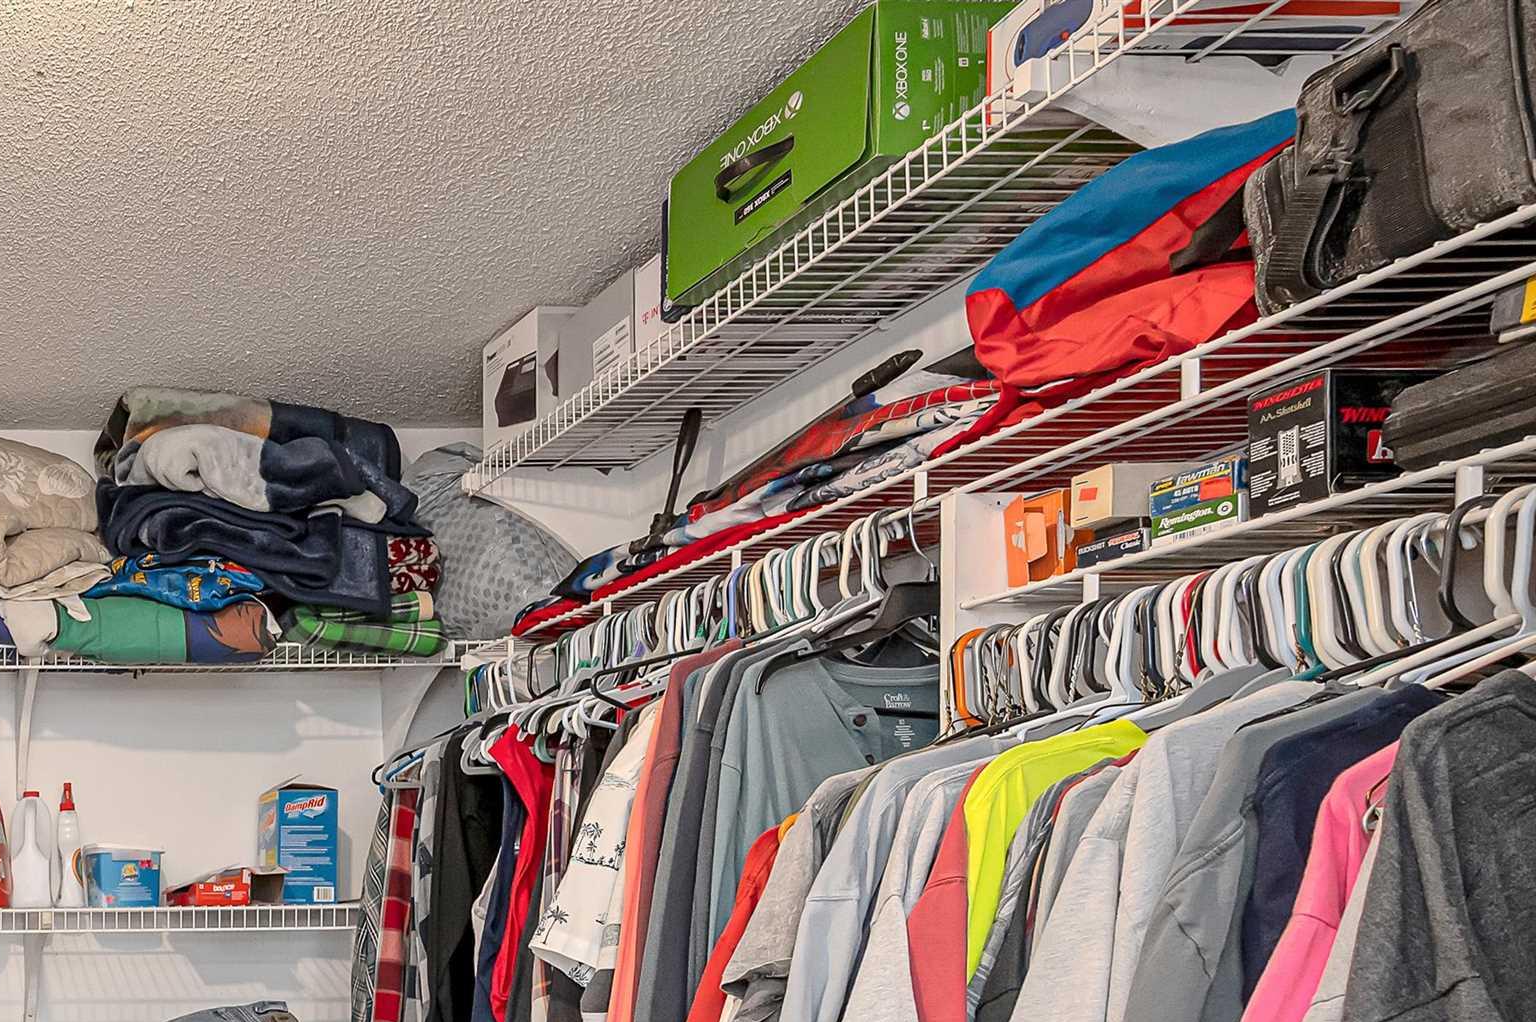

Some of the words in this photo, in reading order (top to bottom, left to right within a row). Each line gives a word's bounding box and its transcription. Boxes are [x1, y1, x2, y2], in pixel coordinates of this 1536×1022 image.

[895, 31, 908, 61] ONE
[895, 61, 908, 100] XBOX
[747, 107, 783, 151] XBOX
[719, 140, 747, 168] ONE
